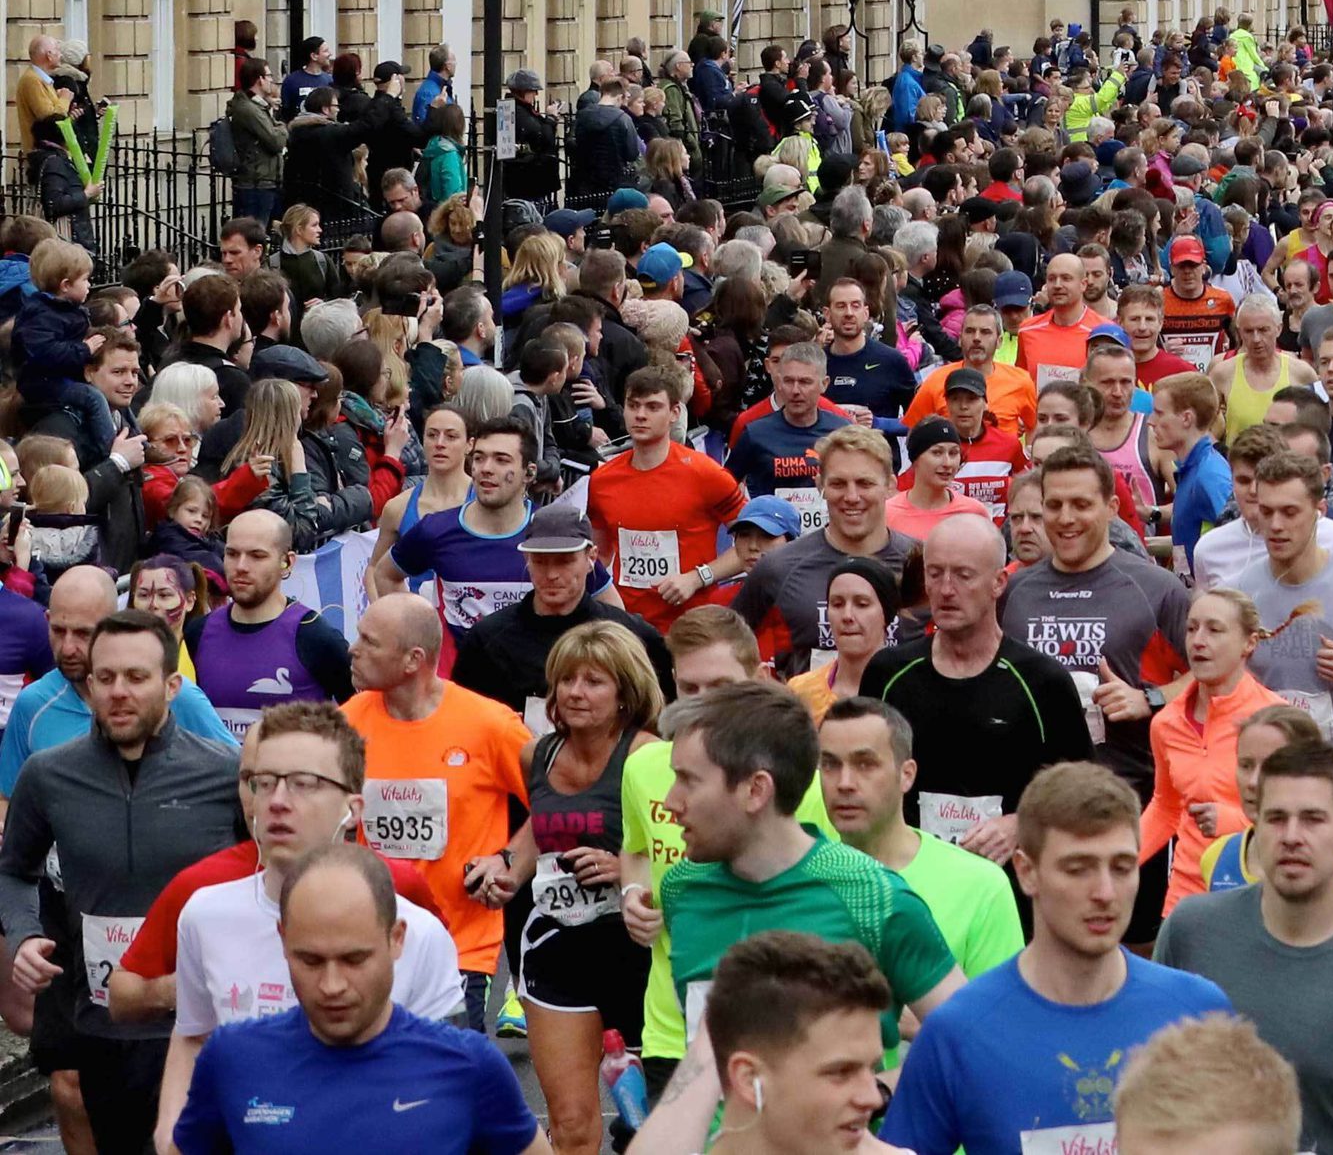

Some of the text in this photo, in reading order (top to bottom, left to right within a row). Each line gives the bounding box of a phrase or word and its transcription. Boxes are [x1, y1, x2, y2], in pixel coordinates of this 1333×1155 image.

[774, 457, 807, 467] PUMA
[774, 466, 821, 478] RUNNIN
[628, 555, 669, 577] 2309
[1027, 622, 1106, 642] LEWIS
[380, 786, 423, 805] Vitality
[938, 801, 981, 822] Vitality
[376, 815, 434, 842] 5935
